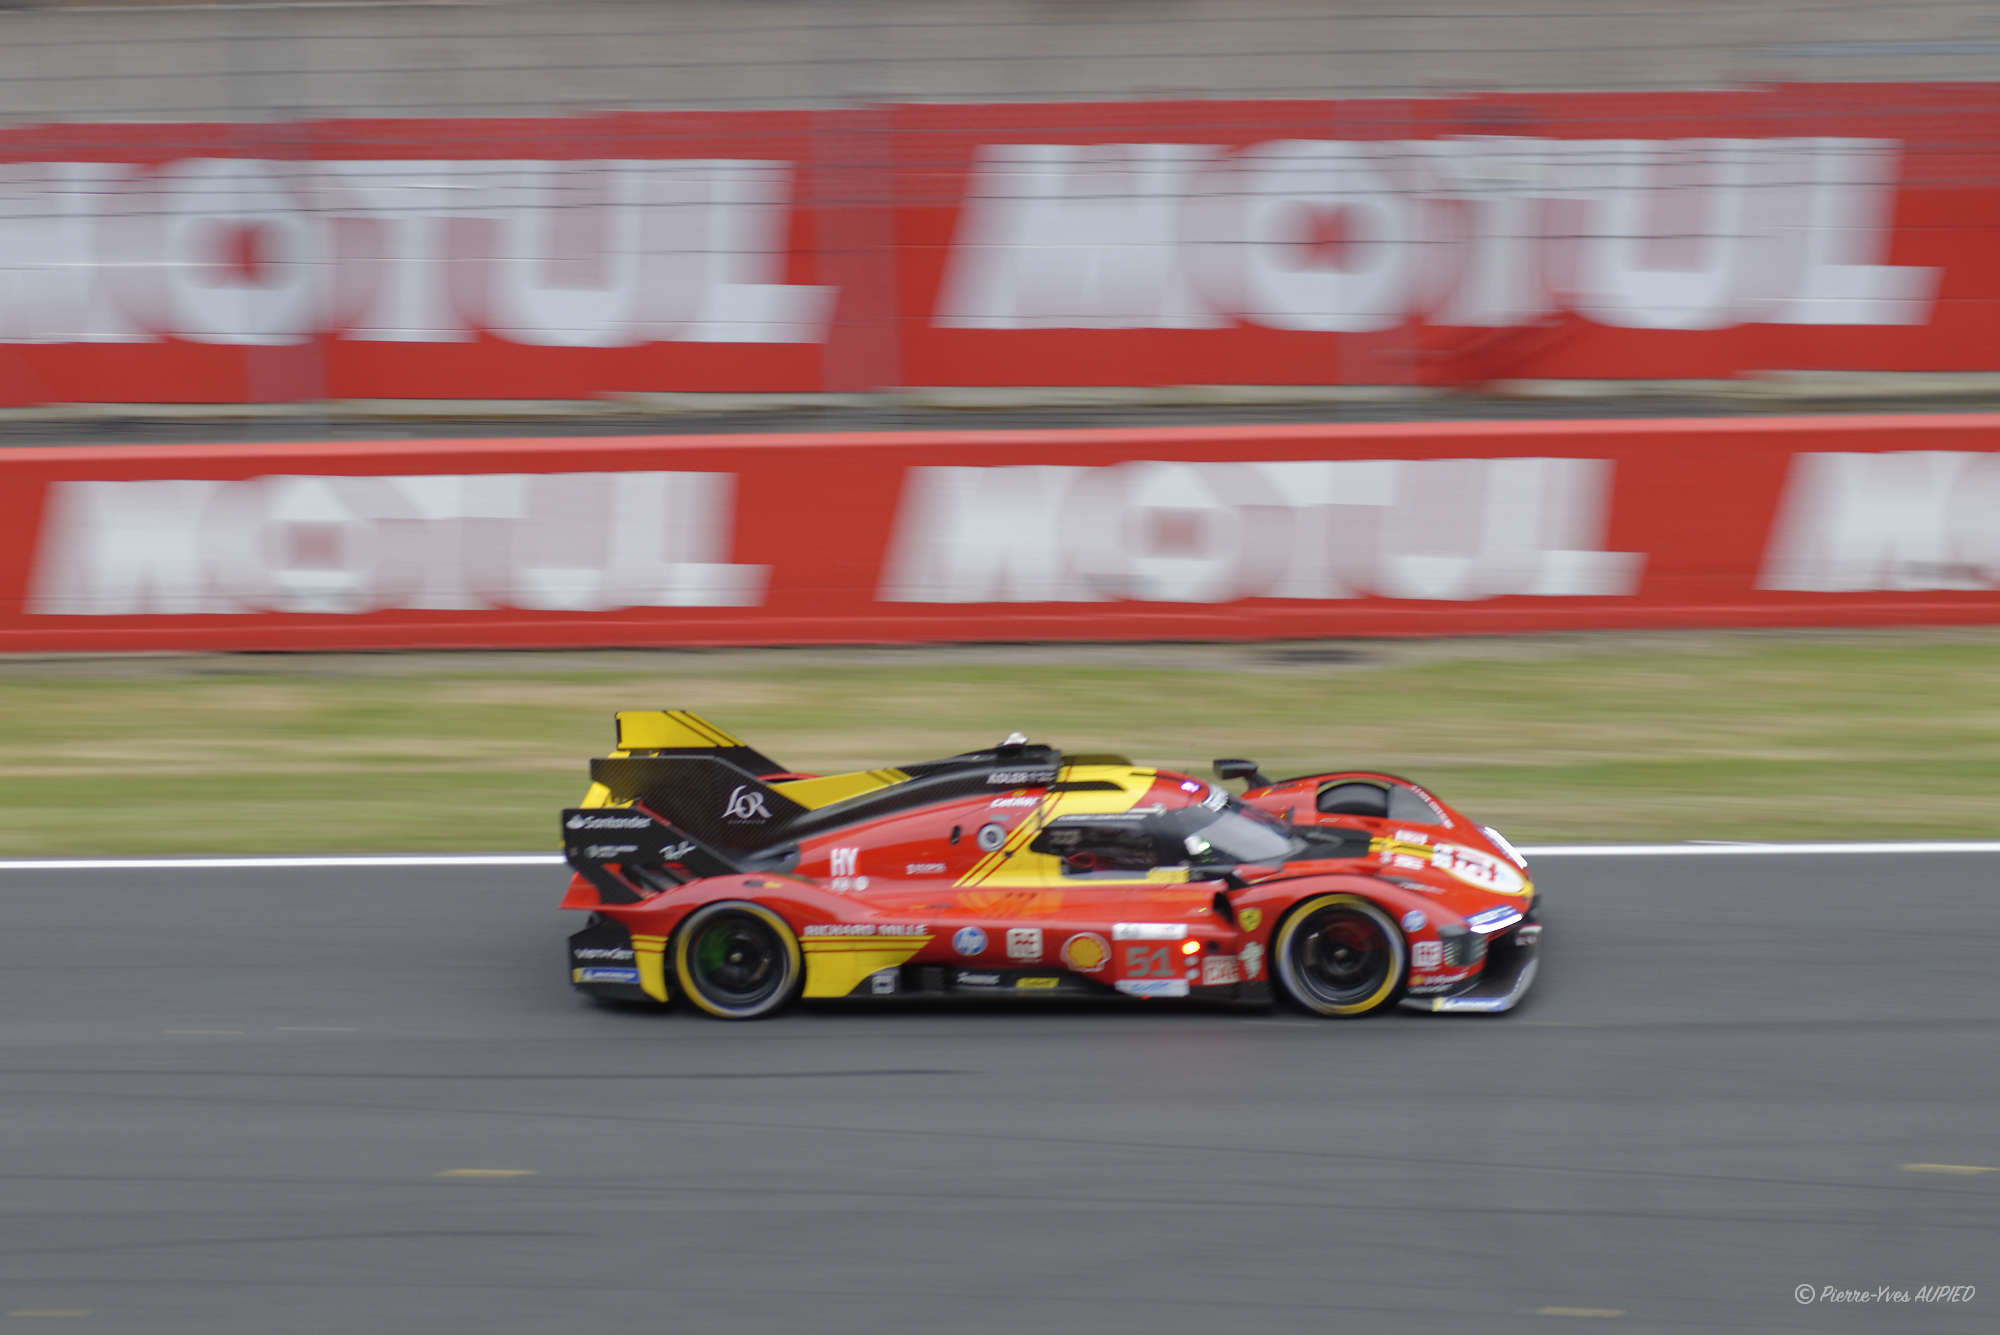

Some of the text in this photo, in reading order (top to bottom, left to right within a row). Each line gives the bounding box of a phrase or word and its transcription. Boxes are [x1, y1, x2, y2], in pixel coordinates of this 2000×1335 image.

[931, 136, 1944, 331] MOTUL
[25, 471, 772, 614] MOTUL
[877, 457, 1647, 603] MOTUL
[1126, 946, 1175, 977] 51
